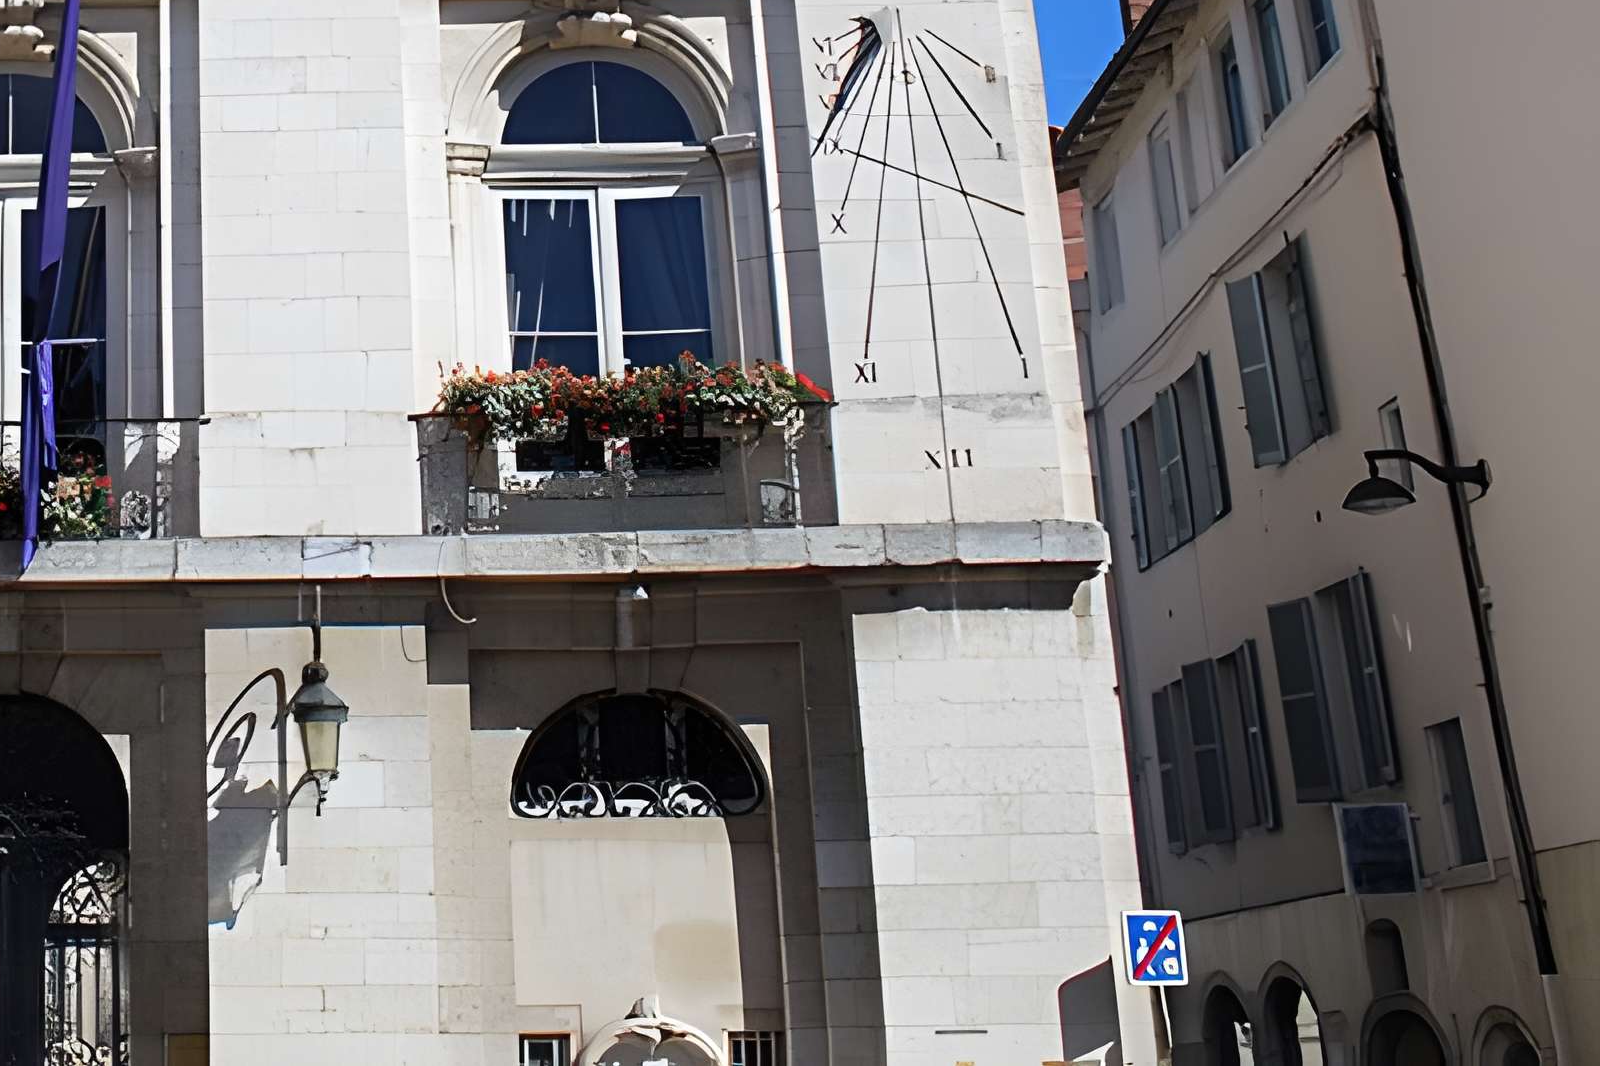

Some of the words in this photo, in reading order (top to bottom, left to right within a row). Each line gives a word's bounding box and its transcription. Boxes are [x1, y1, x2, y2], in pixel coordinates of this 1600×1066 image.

[831, 213, 848, 234] X
[854, 361, 877, 384] XI
[924, 448, 973, 470] XII
